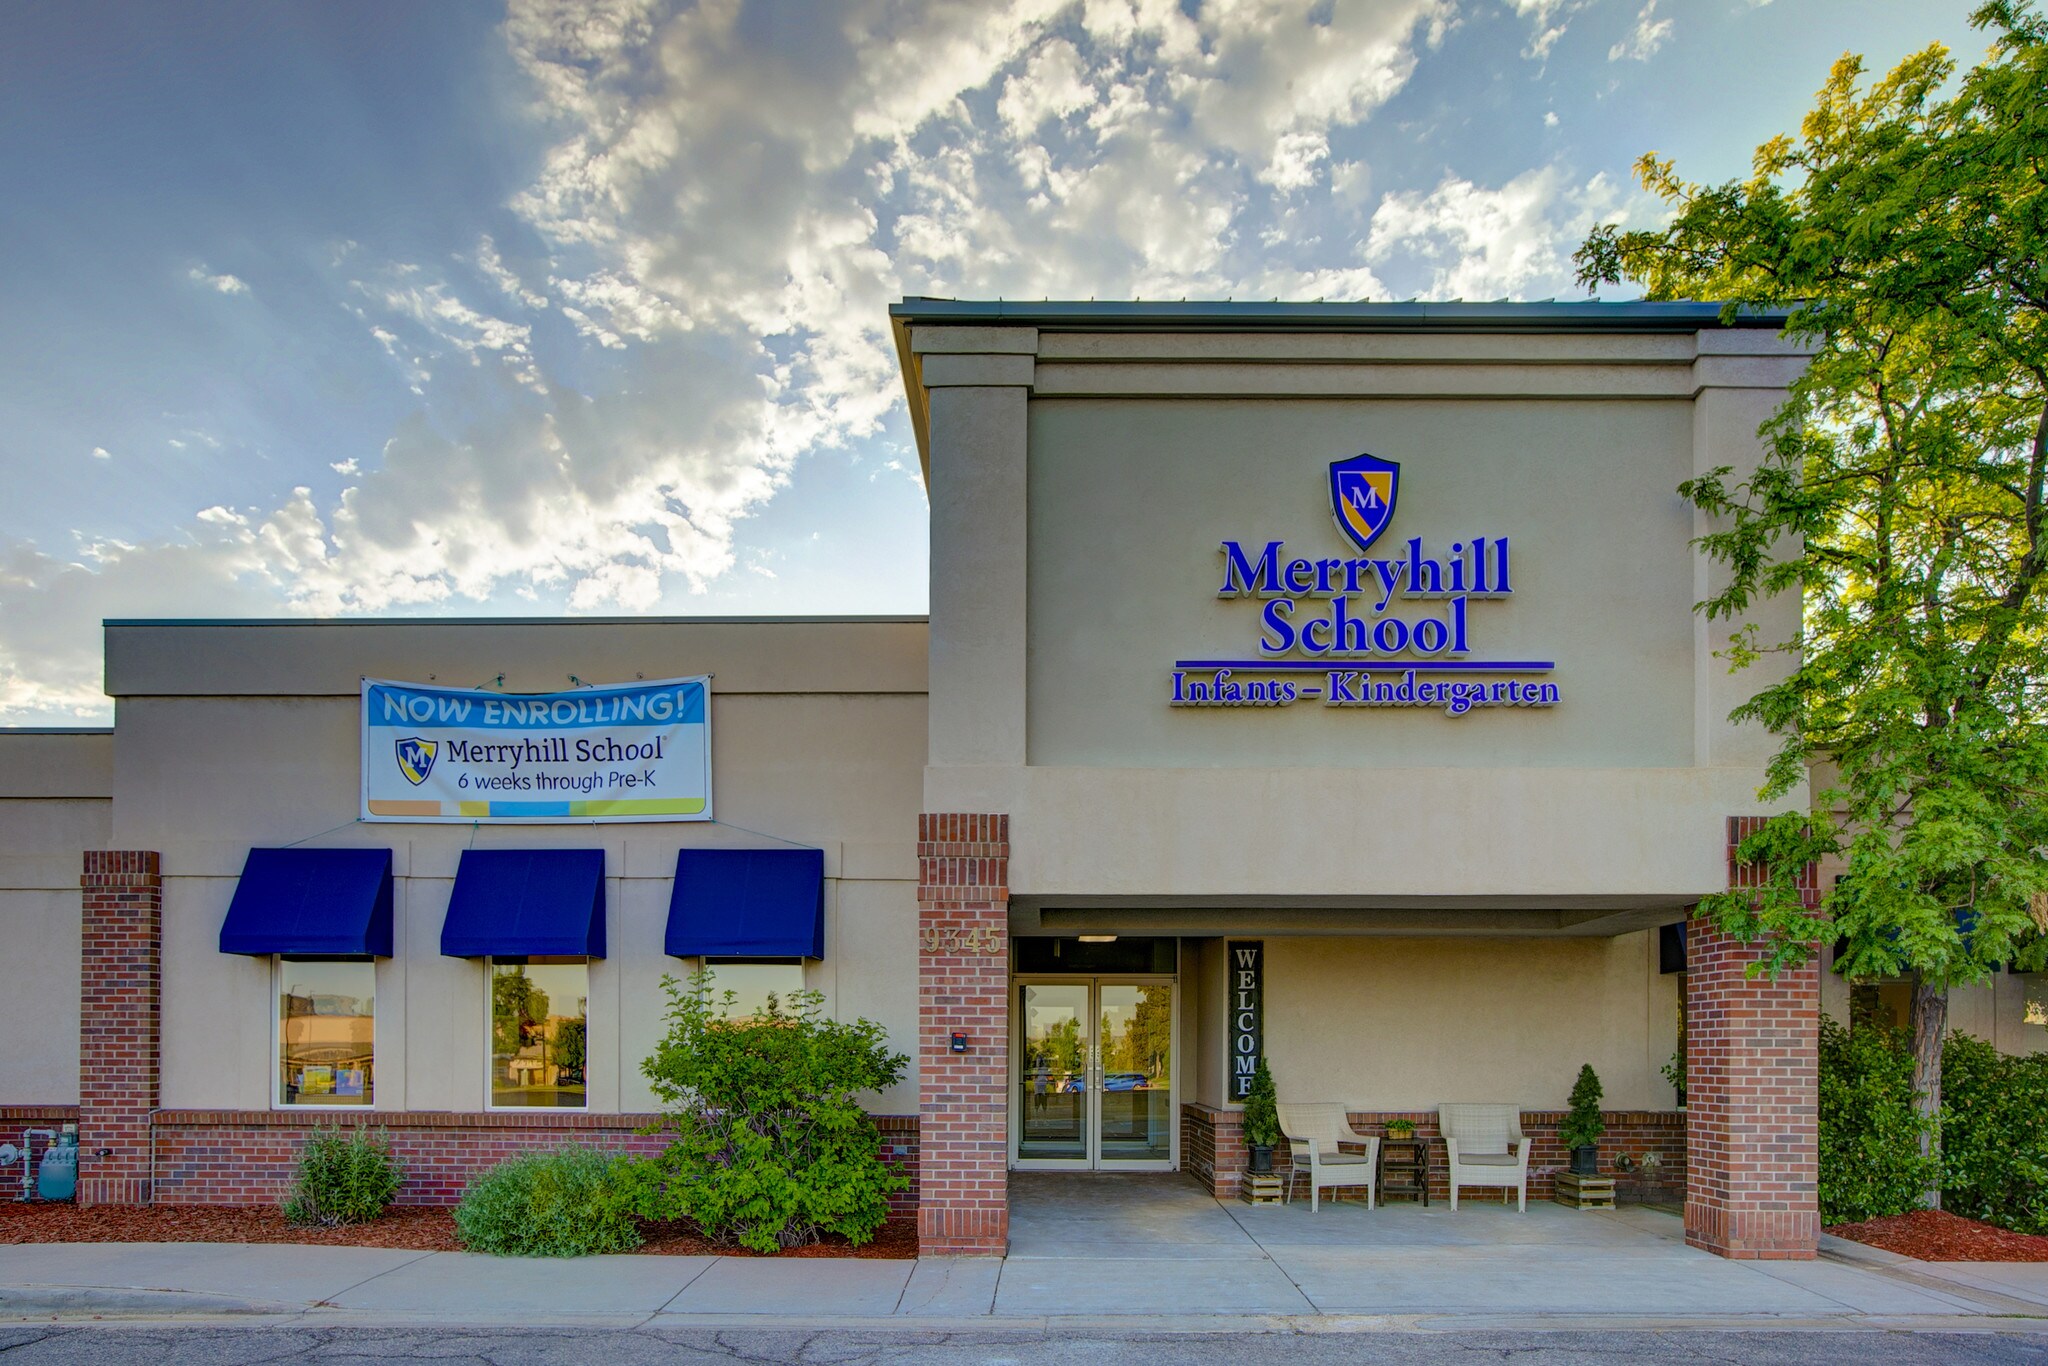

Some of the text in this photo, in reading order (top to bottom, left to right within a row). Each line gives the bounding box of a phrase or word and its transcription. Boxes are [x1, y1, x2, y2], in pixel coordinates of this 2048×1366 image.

[1351, 487, 1378, 509] M
[1218, 536, 1514, 617] Merryhill
[1259, 595, 1470, 657] School
[384, 690, 684, 725] NOW ENROLLING!
[1170, 670, 1296, 706] Infants
[1327, 670, 1560, 717] Kindergarten
[405, 746, 427, 768] M
[447, 736, 663, 769] Merryhill School
[458, 770, 656, 793] 6 weeks through Pre-K
[924, 927, 1001, 953] 9345
[1235, 949, 1257, 1095] WELCOME
